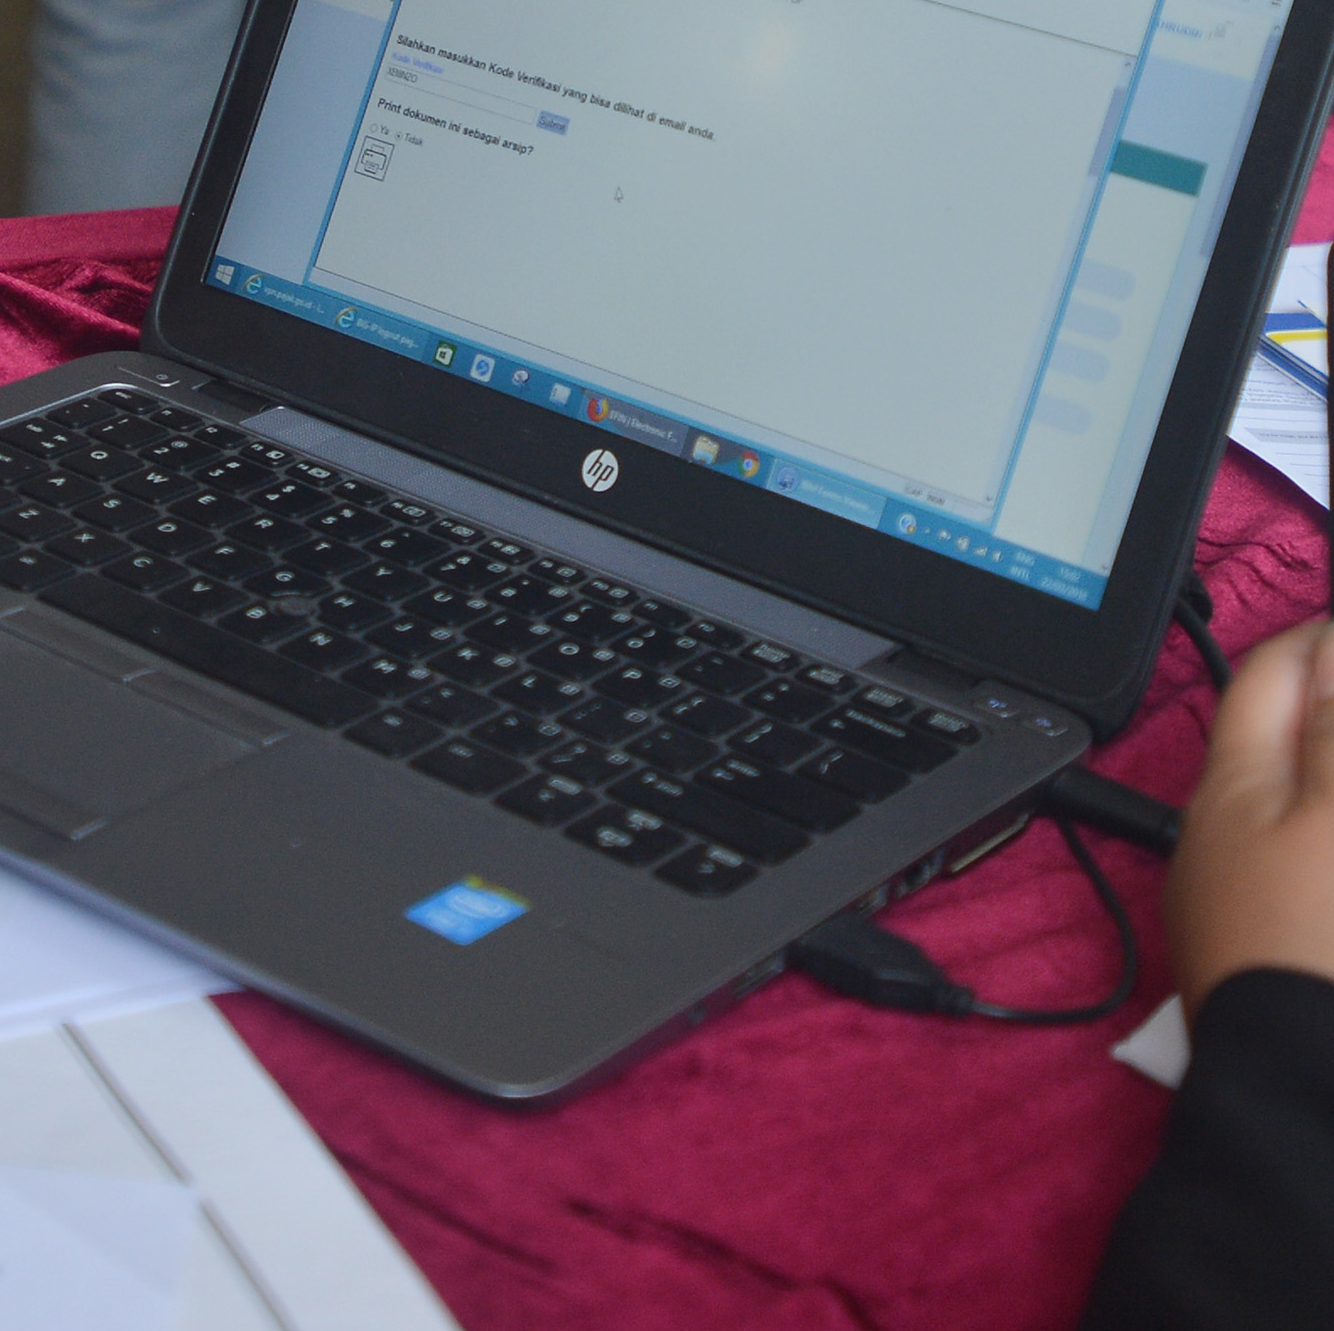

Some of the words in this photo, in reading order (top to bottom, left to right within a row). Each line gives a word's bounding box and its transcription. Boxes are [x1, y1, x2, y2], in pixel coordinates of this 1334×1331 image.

[396, 34, 436, 56] Silahkan
[438, 48, 487, 70] masukkan
[488, 62, 514, 79] Kode
[517, 69, 562, 95] Verifikasi
[562, 83, 588, 105] yang
[589, 92, 612, 109] bisa
[613, 99, 645, 123] dilihat
[647, 110, 657, 123] di
[658, 114, 686, 131] email
[377, 98, 402, 114] Print
[403, 108, 447, 129] dokumen
[448, 120, 461, 133] ini
[462, 125, 501, 147] sebagai
[502, 136, 534, 156] arsip?
[380, 125, 389, 136] Ya
[582, 449, 619, 492] hp
